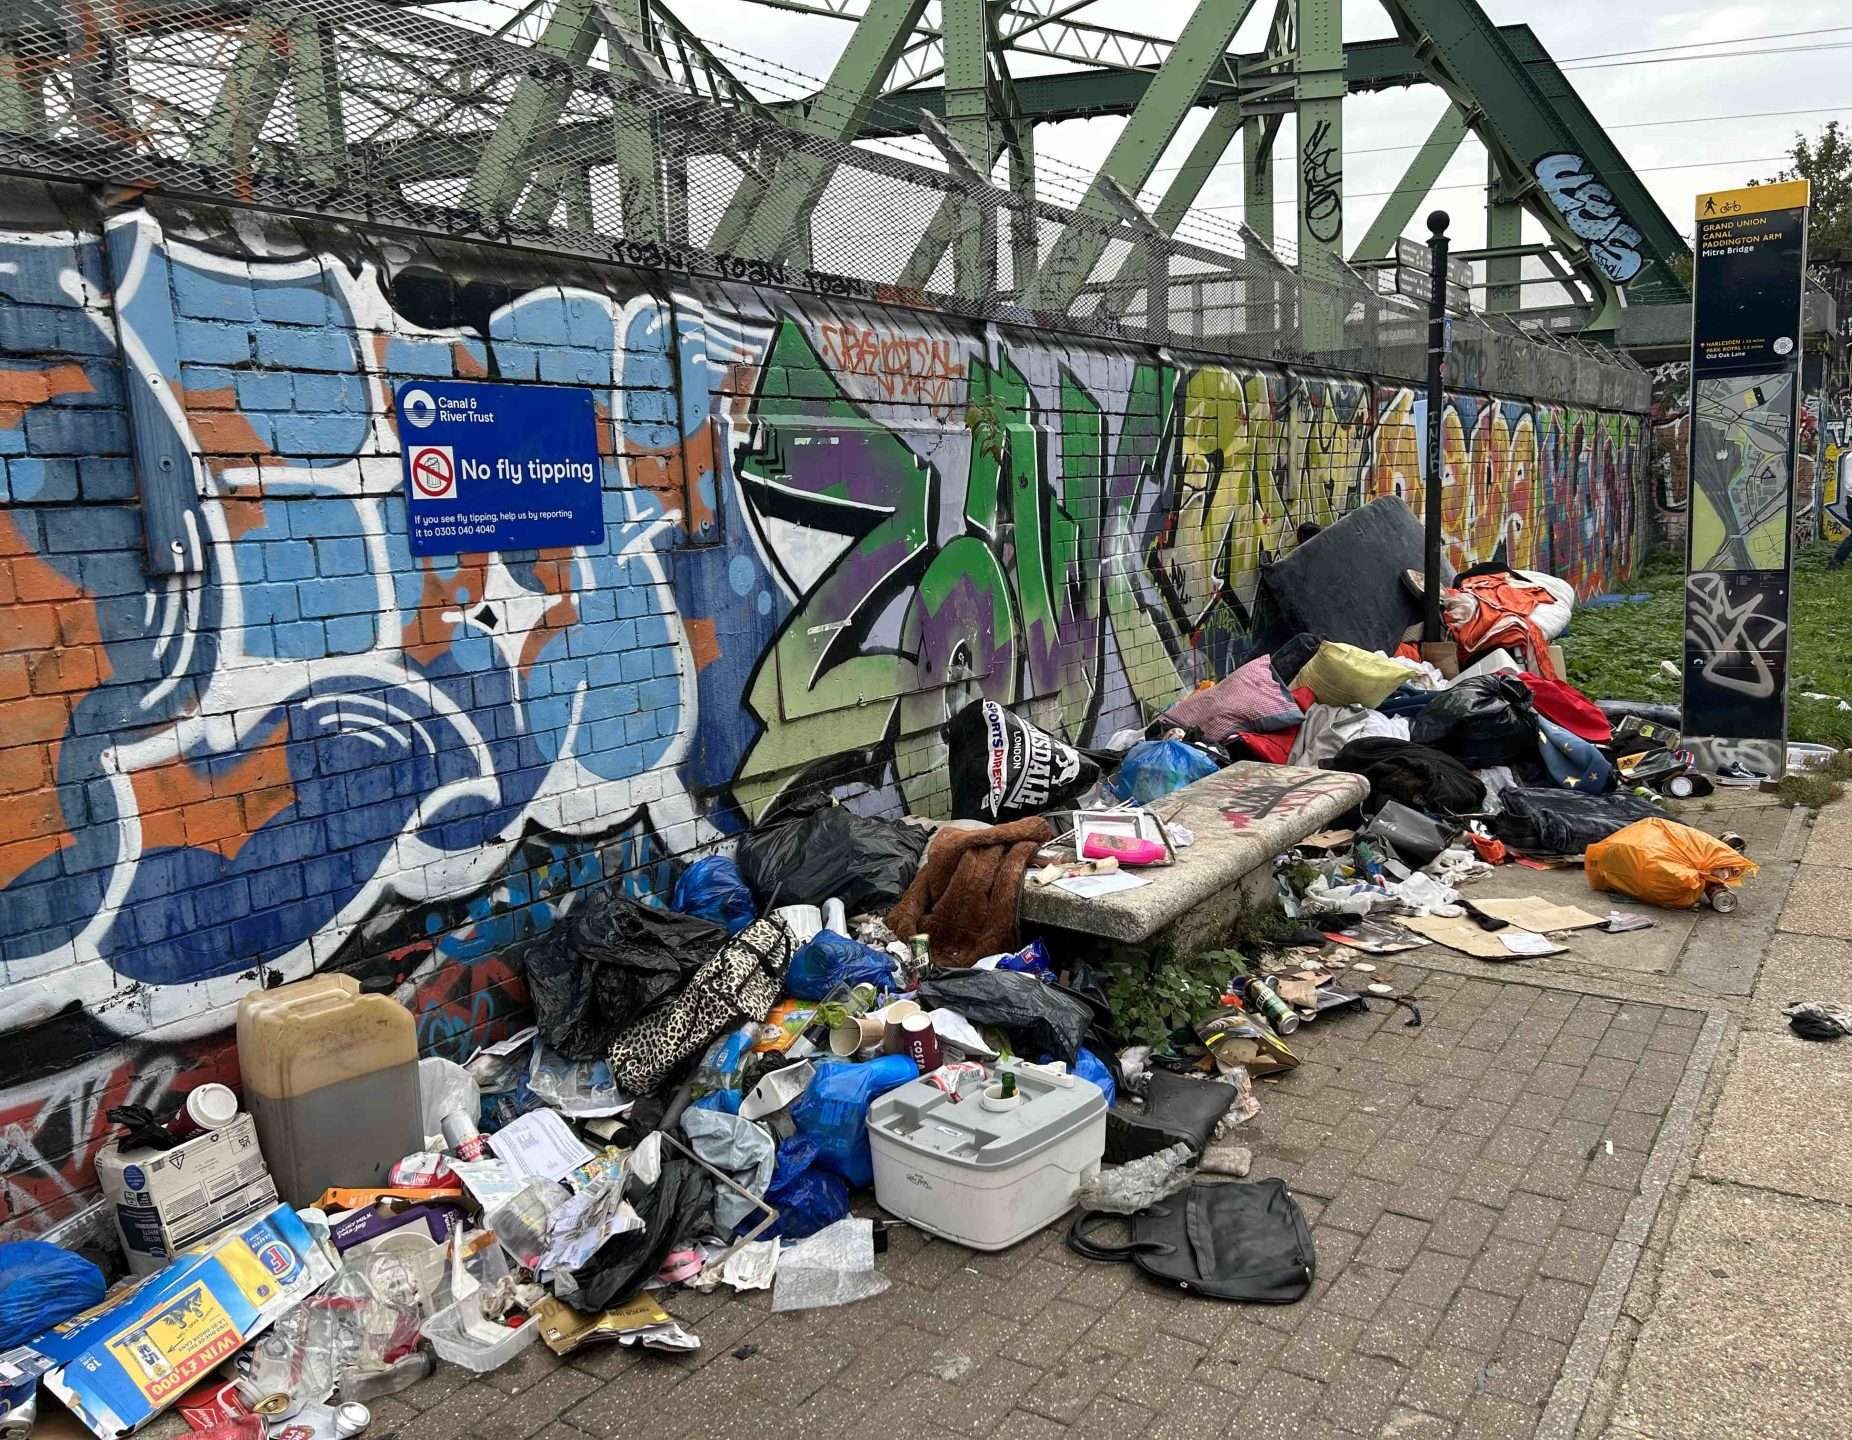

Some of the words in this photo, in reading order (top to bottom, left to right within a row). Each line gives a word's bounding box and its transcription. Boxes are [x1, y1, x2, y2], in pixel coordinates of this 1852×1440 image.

[1703, 222, 1734, 232] GRAND
[1736, 217, 1767, 227] UNION
[1702, 231, 1732, 240] CANAL
[1702, 236, 1760, 249] PADDINGTON
[1762, 233, 1782, 241] ARM
[1702, 249, 1725, 257] Mitre
[1727, 245, 1754, 254] Bridge
[438, 397, 469, 409] Canal
[470, 398, 477, 409] &
[440, 411, 467, 423] River
[469, 411, 494, 423] Trust
[461, 459, 490, 480] No
[496, 459, 523, 485] fly
[528, 459, 594, 484] tipping
[414, 514, 422, 524] If
[423, 516, 439, 526] you
[441, 515, 455, 523] see
[457, 513, 468, 524] fly
[500, 511, 516, 522] help
[518, 512, 527, 520] us
[528, 511, 538, 521] by
[539, 510, 573, 520] reporting
[416, 527, 422, 537] it
[424, 528, 433, 537] to
[434, 526, 457, 537] 0303
[458, 525, 474, 535] 040
[475, 524, 496, 534] 4040
[1013, 731, 1022, 769] LONDON
[199, 1335, 235, 1364] WIN
[86, 1359, 102, 1372] 18
[150, 1358, 199, 1395] £1,000
